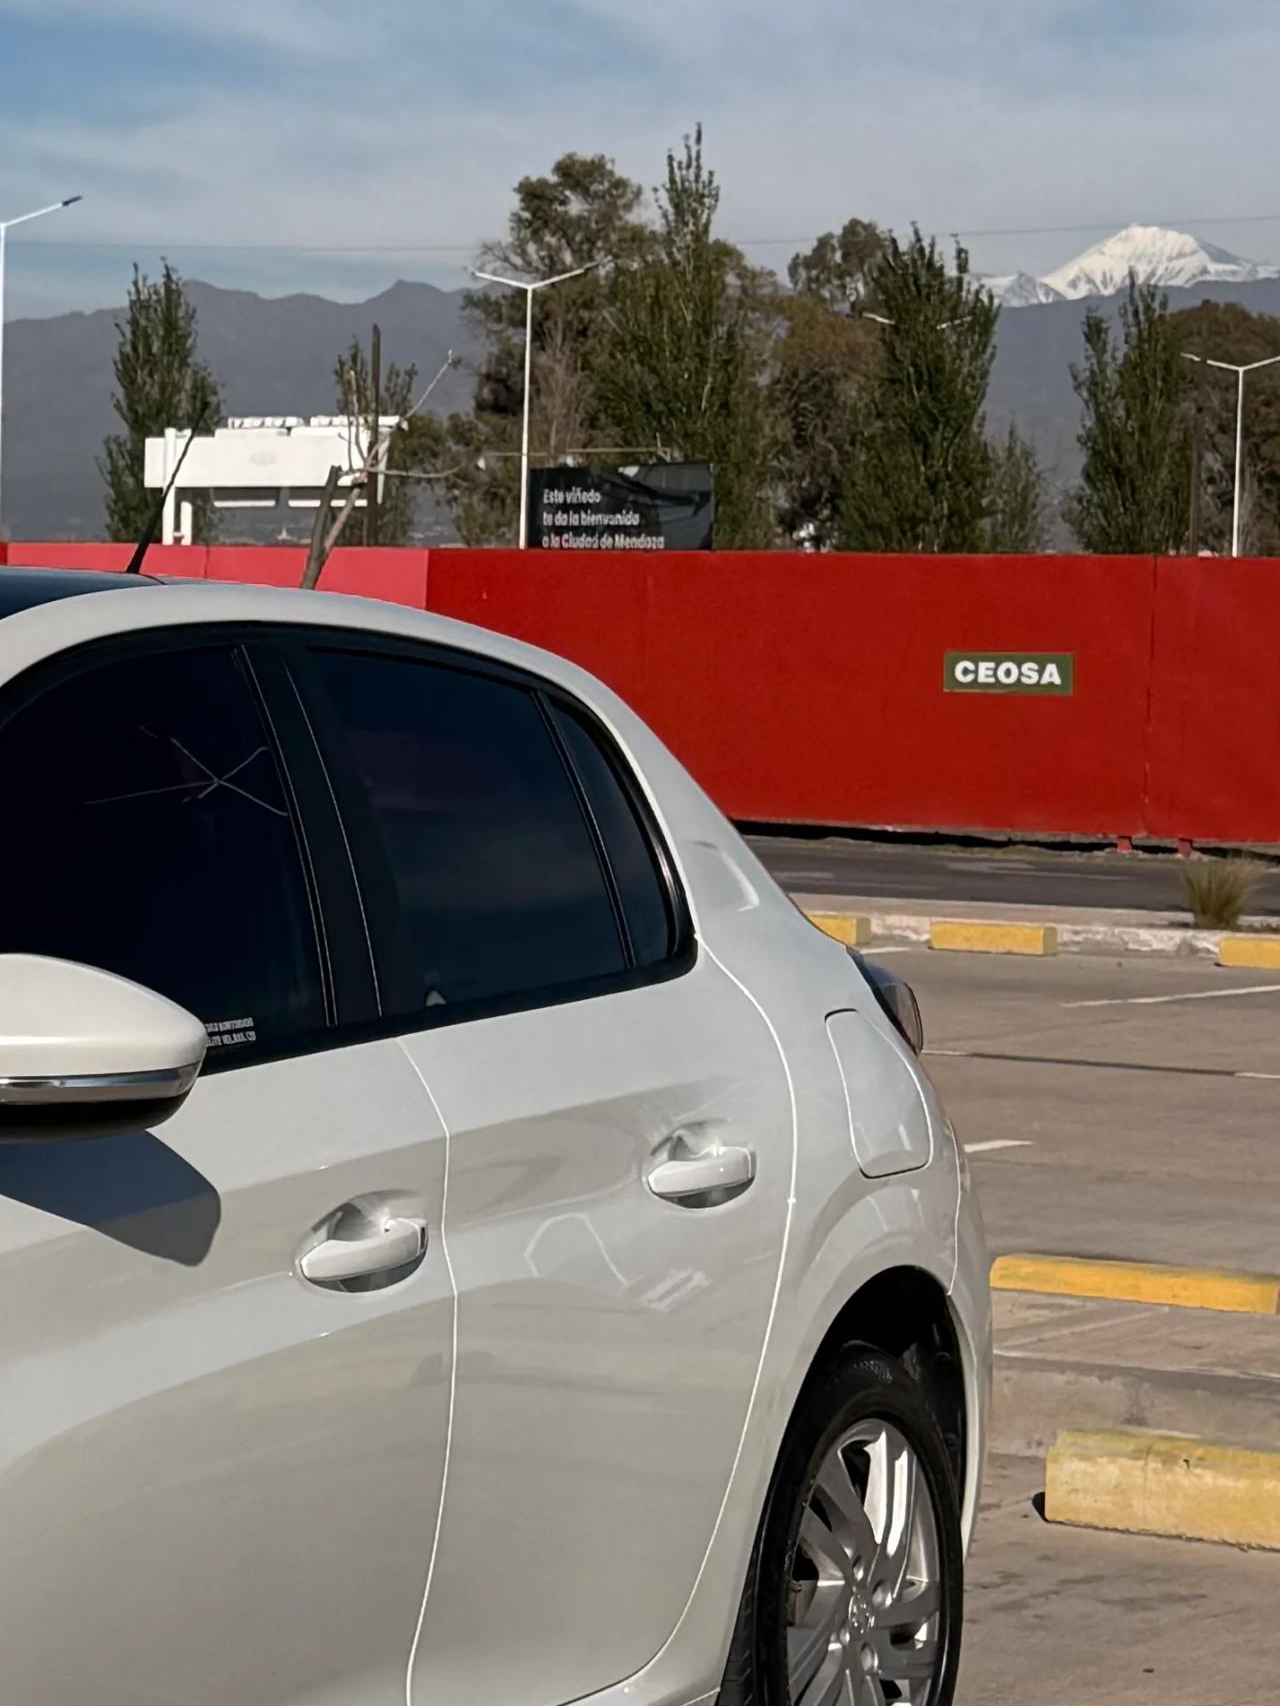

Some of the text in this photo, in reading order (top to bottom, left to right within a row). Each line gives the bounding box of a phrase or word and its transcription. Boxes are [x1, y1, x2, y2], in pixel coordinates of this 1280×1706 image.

[543, 486, 601, 504] Este viñedo
[543, 511, 553, 526] te
[554, 510, 568, 526] da
[569, 510, 580, 526] la
[561, 532, 599, 549] Ciudad
[600, 533, 613, 549] de
[614, 533, 665, 549] Mendoza
[954, 660, 1062, 685] CEOSA
